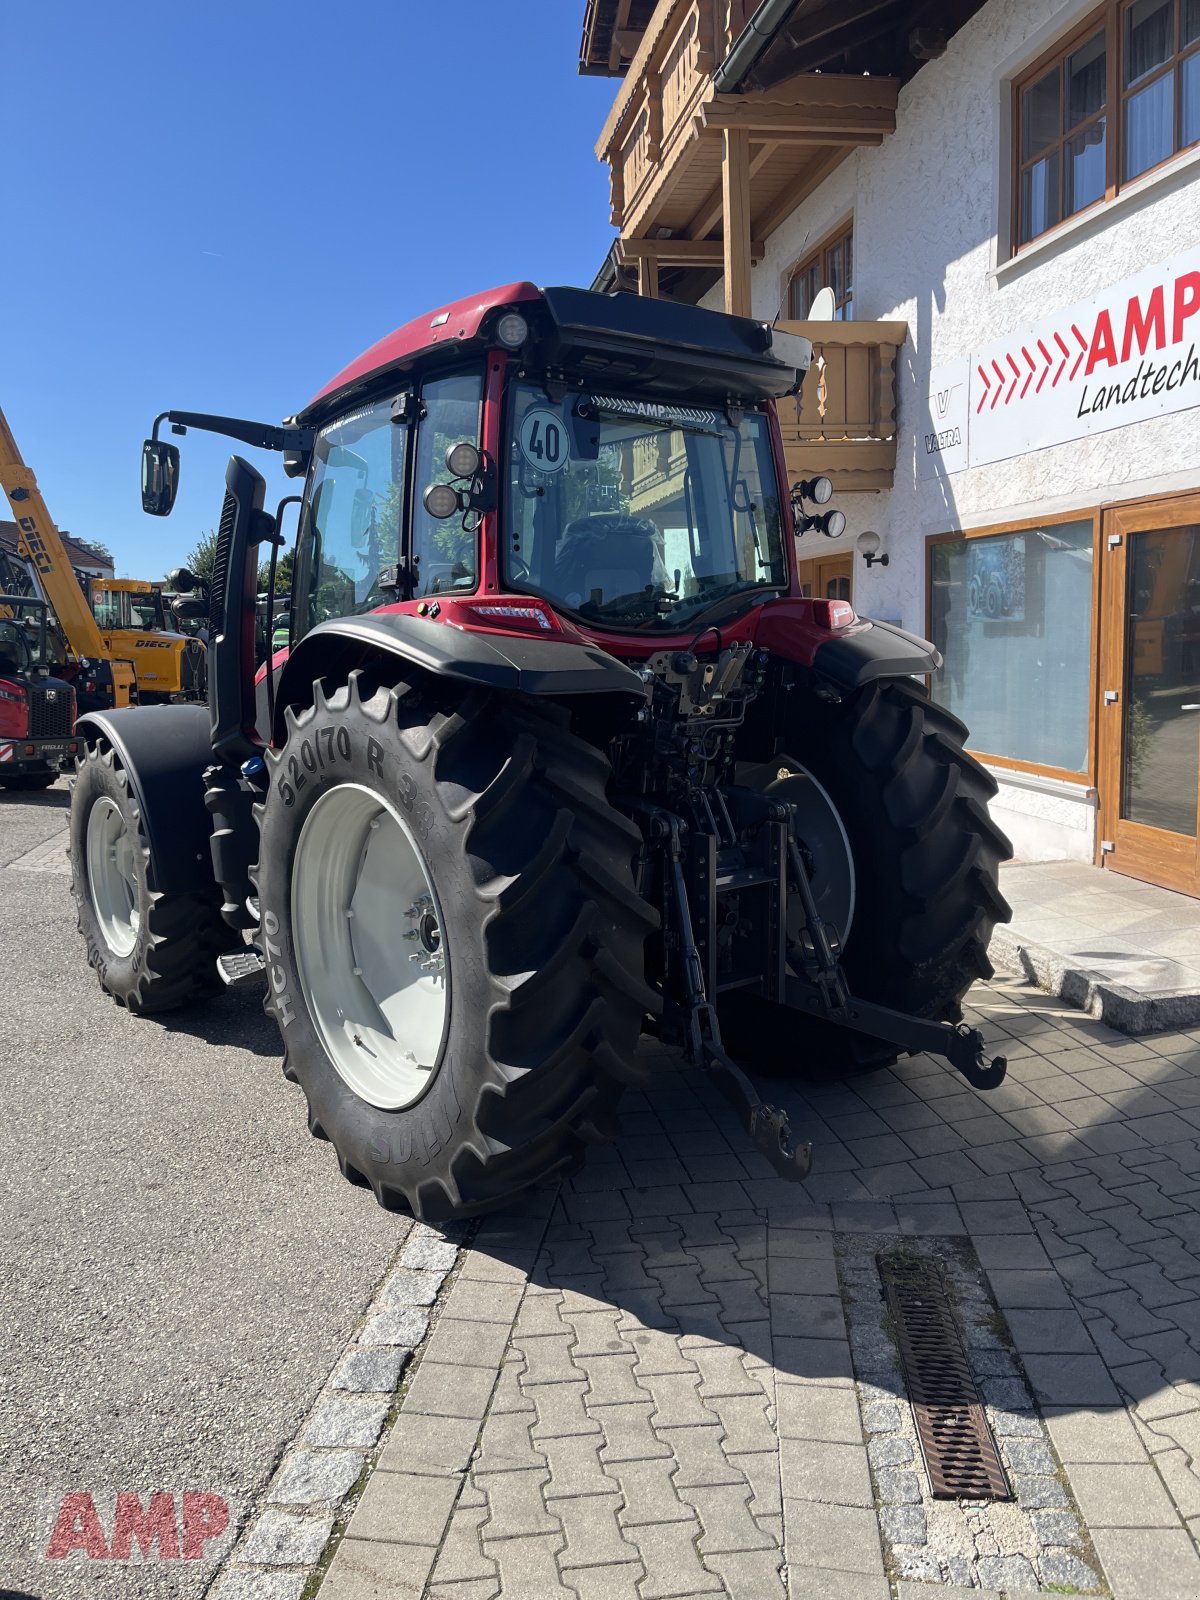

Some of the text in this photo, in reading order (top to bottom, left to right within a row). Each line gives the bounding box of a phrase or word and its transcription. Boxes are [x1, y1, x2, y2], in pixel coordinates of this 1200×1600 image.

[1084, 271, 1200, 376] AMP
[1077, 343, 1200, 419] Landtech
[529, 420, 560, 464] 40
[924, 426, 962, 454] VALTRA
[278, 726, 352, 808] 520/70
[366, 735, 385, 779] R
[264, 910, 297, 1028] HC70
